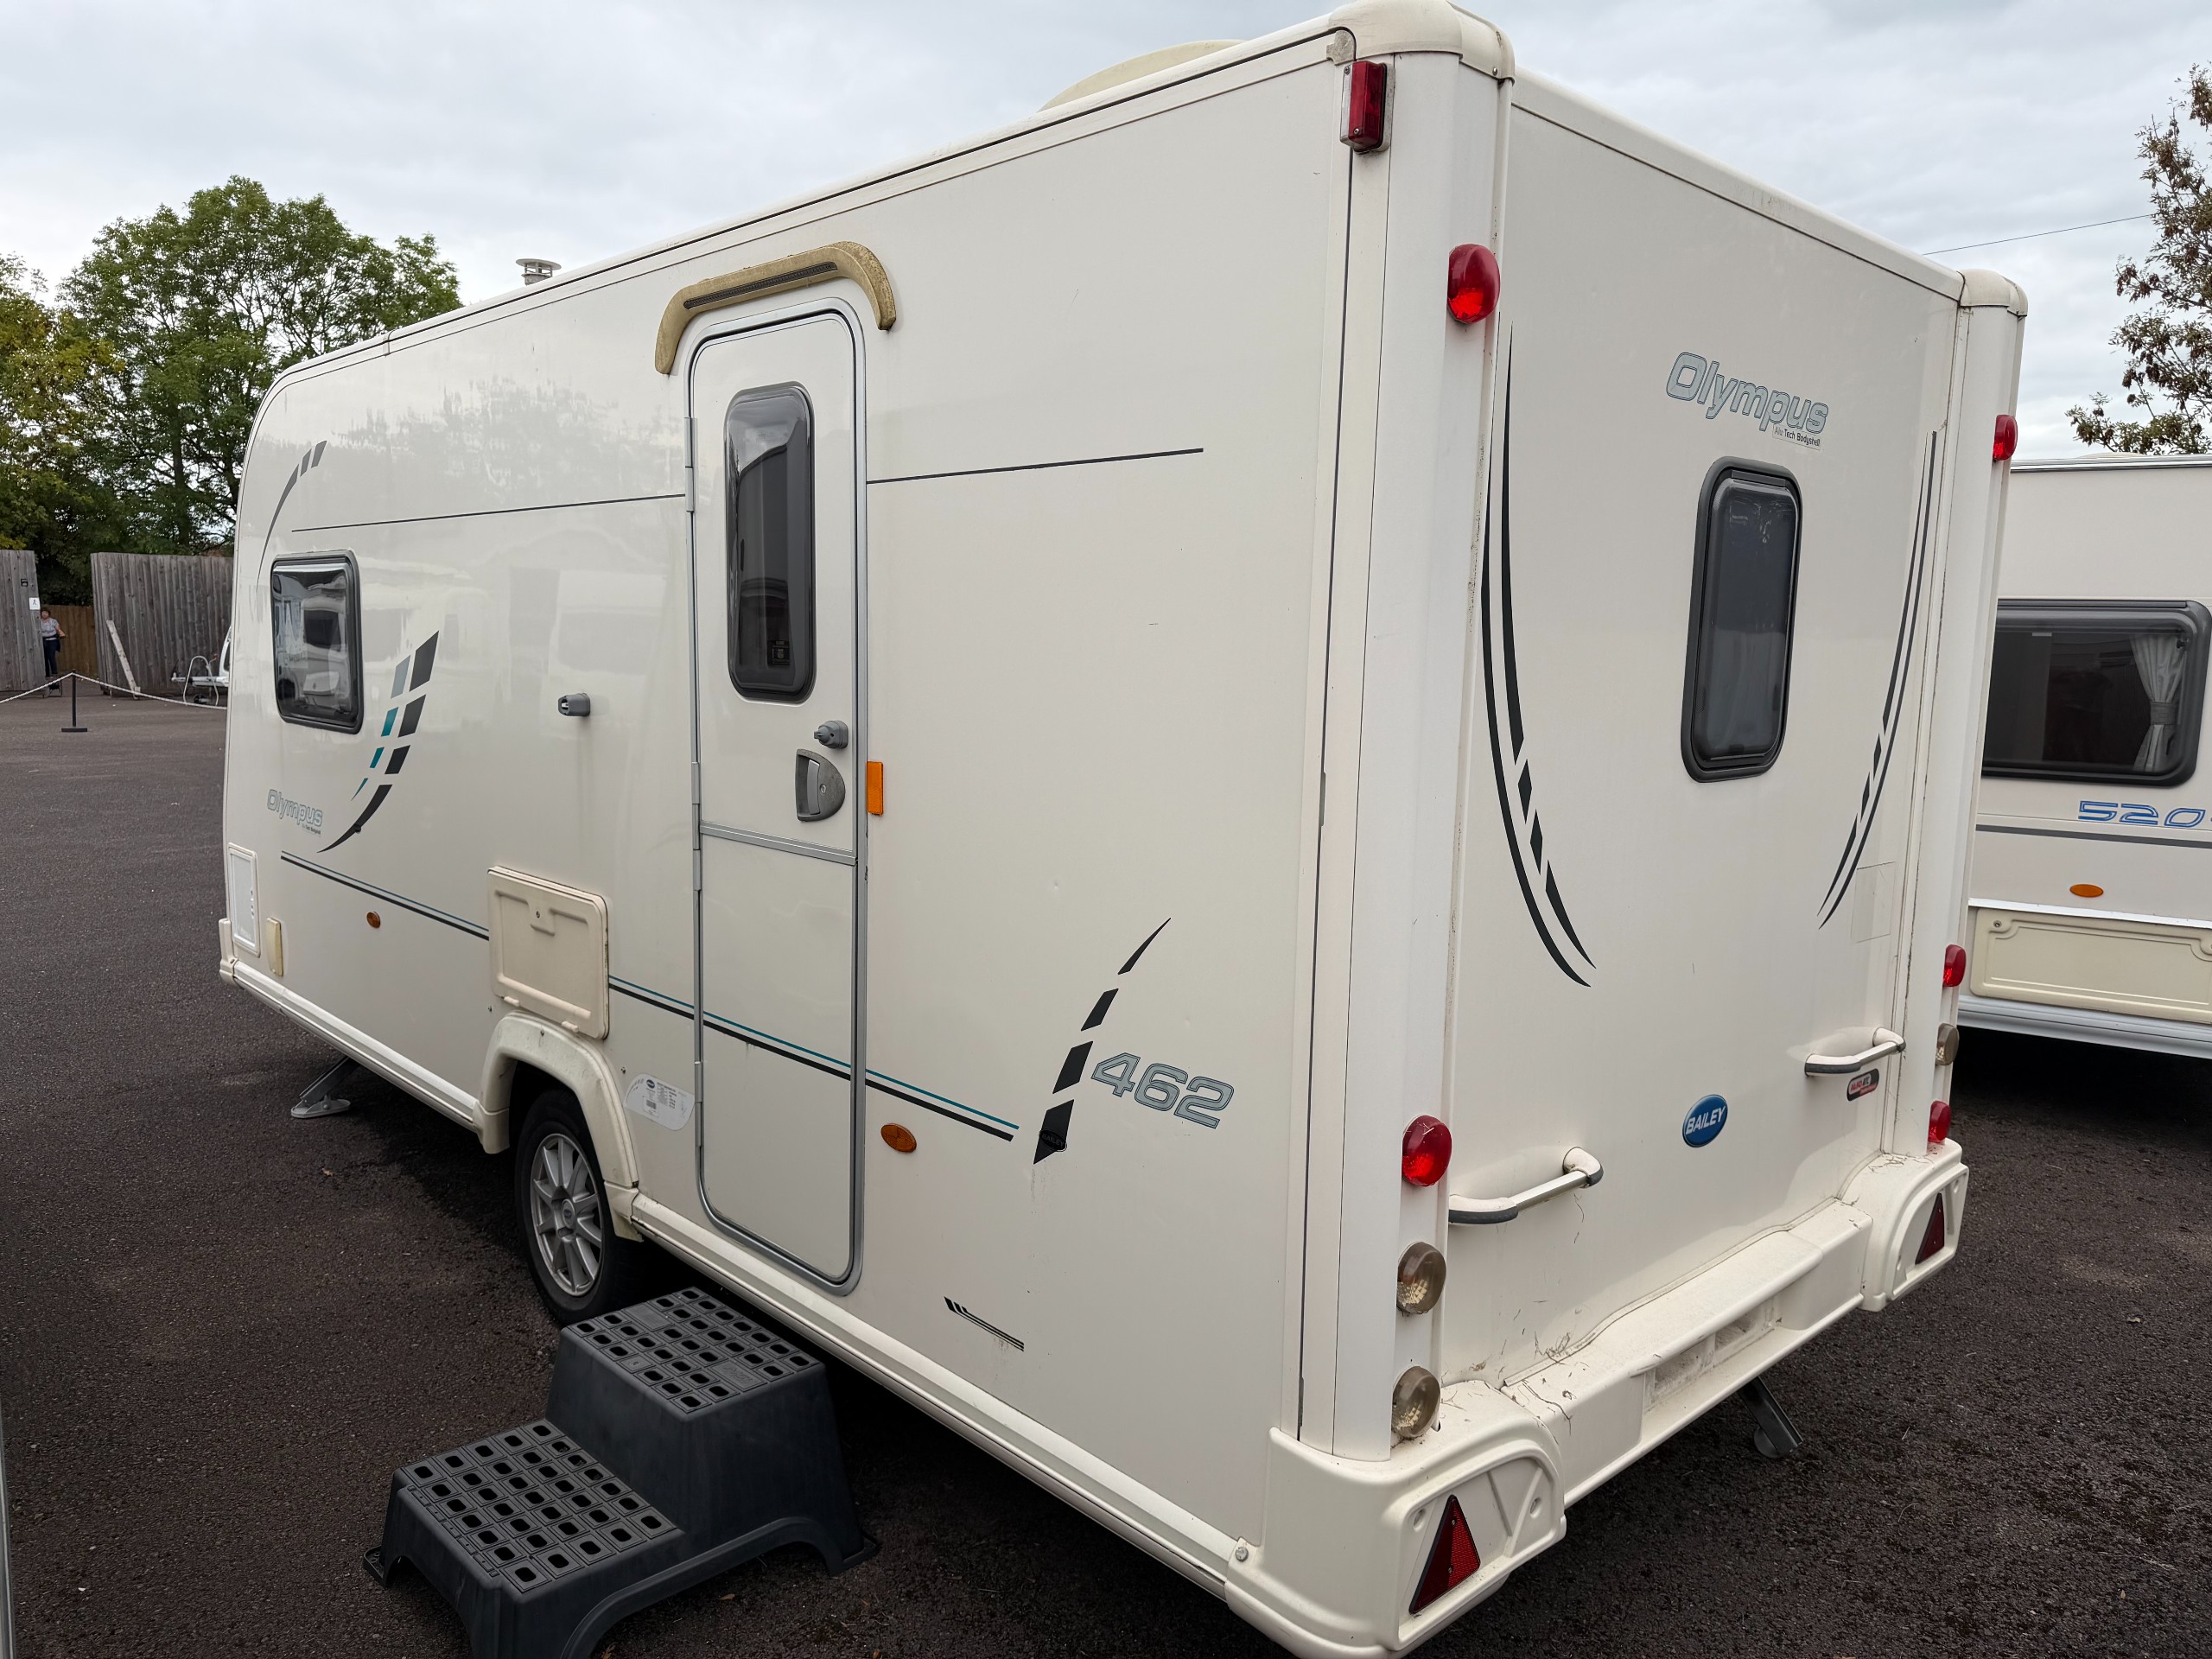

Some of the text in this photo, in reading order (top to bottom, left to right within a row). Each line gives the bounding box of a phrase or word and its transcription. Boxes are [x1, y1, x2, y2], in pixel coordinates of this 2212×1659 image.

[1666, 352, 1828, 434] Olympus
[267, 789, 323, 827] Olympus
[1090, 1052, 1235, 1129] 462
[1686, 1105, 1726, 1135] BAILEY
[1041, 1134, 1065, 1149] BAILEY
